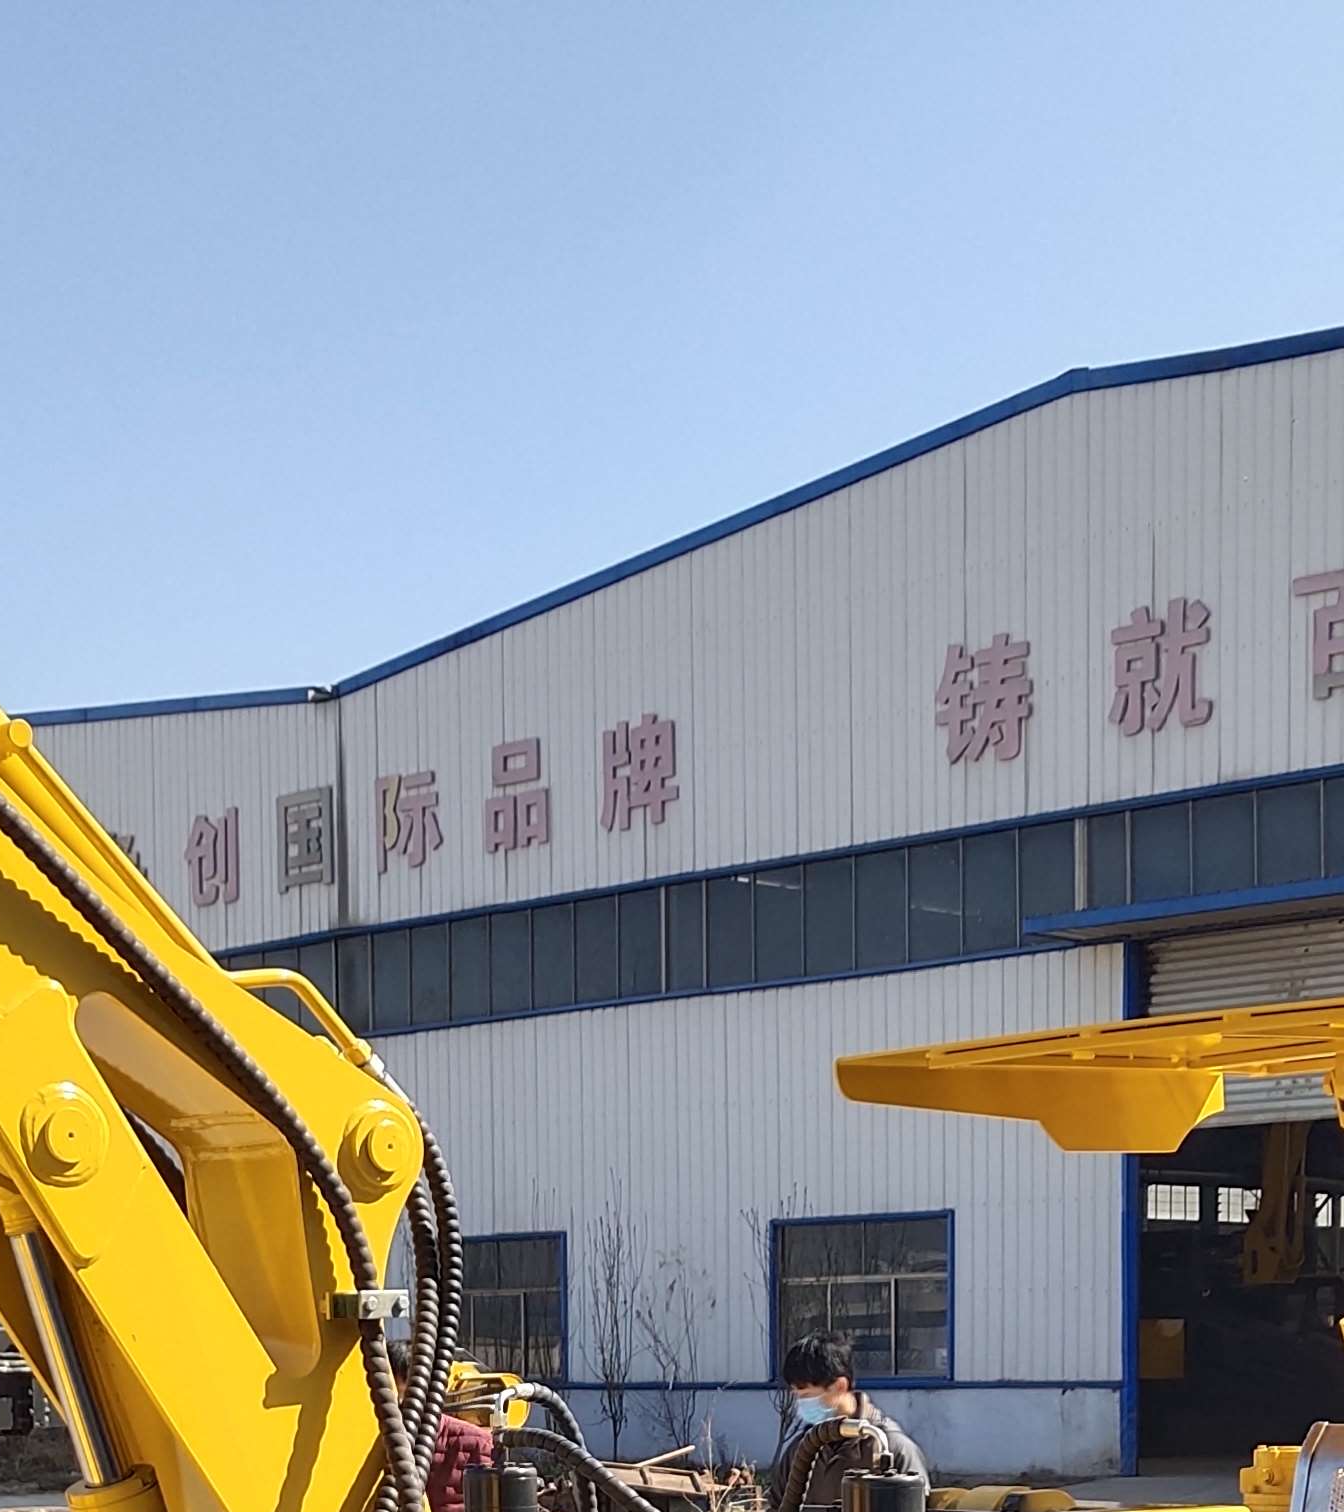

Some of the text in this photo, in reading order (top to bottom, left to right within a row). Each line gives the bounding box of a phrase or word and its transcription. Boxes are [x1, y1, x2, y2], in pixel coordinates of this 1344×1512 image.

[111, 713, 680, 906] 创国际品牌
